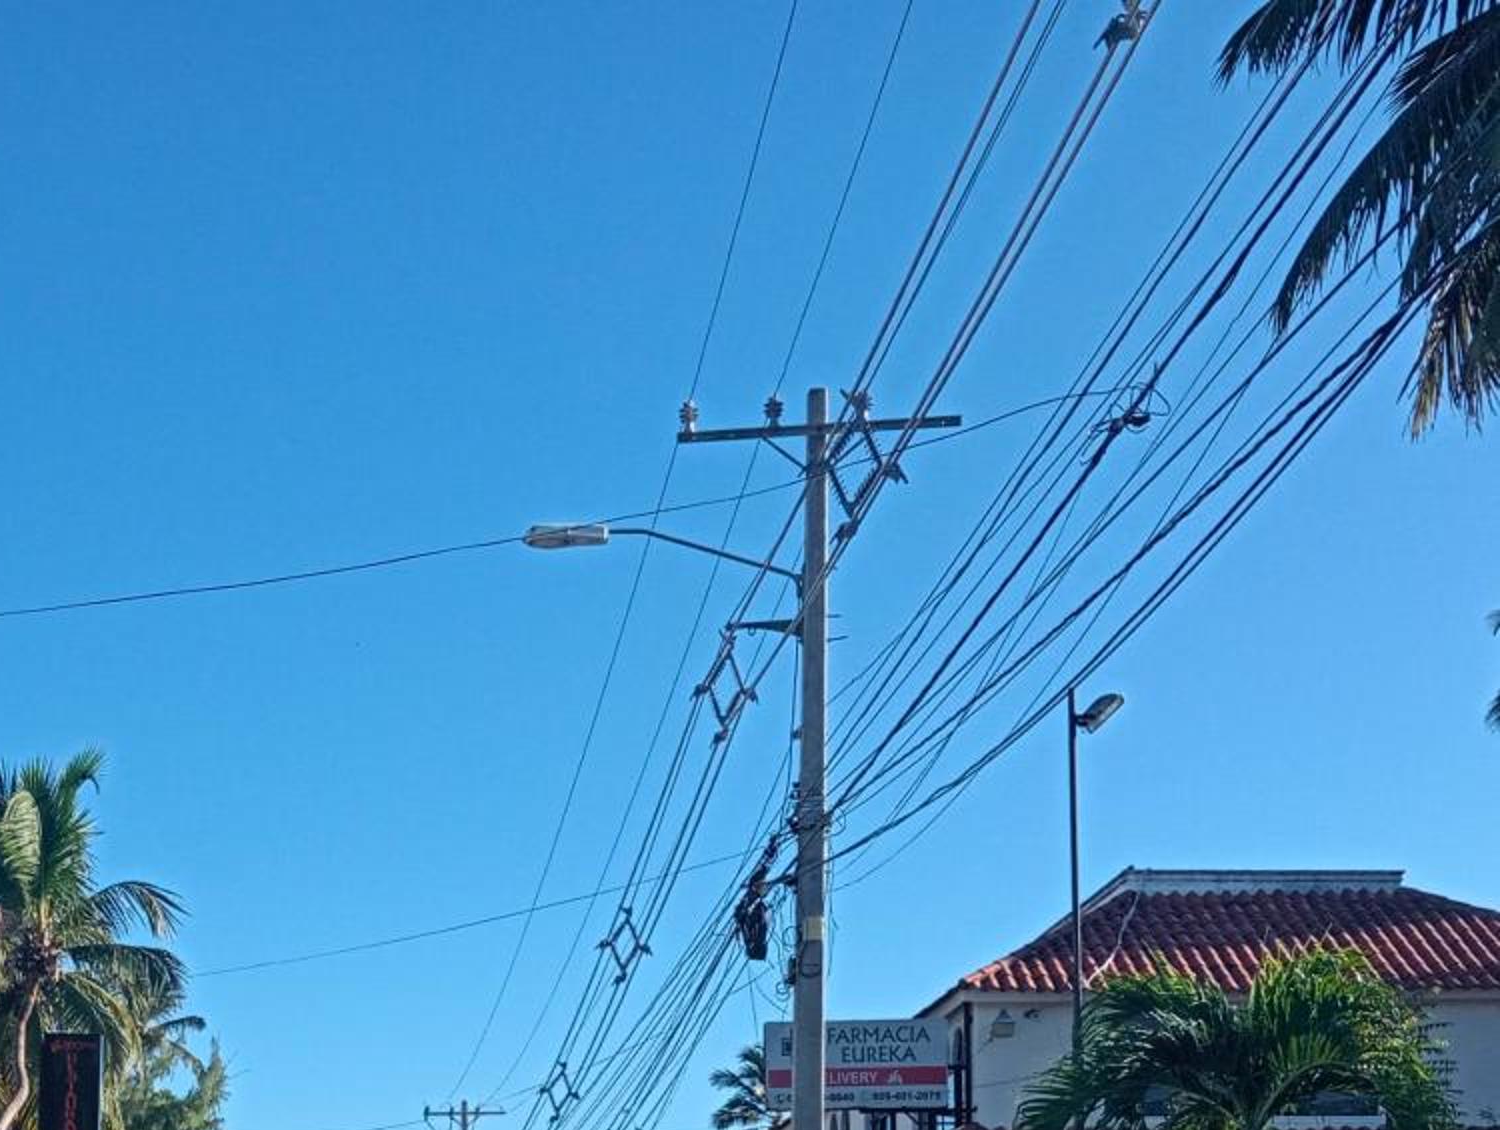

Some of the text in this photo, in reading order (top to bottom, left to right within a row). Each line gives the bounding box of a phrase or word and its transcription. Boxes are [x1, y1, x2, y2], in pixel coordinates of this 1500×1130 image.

[826, 1025, 931, 1044] FARMACIA
[841, 1045, 917, 1064] EUREKA
[828, 1071, 878, 1085] LIVERY
